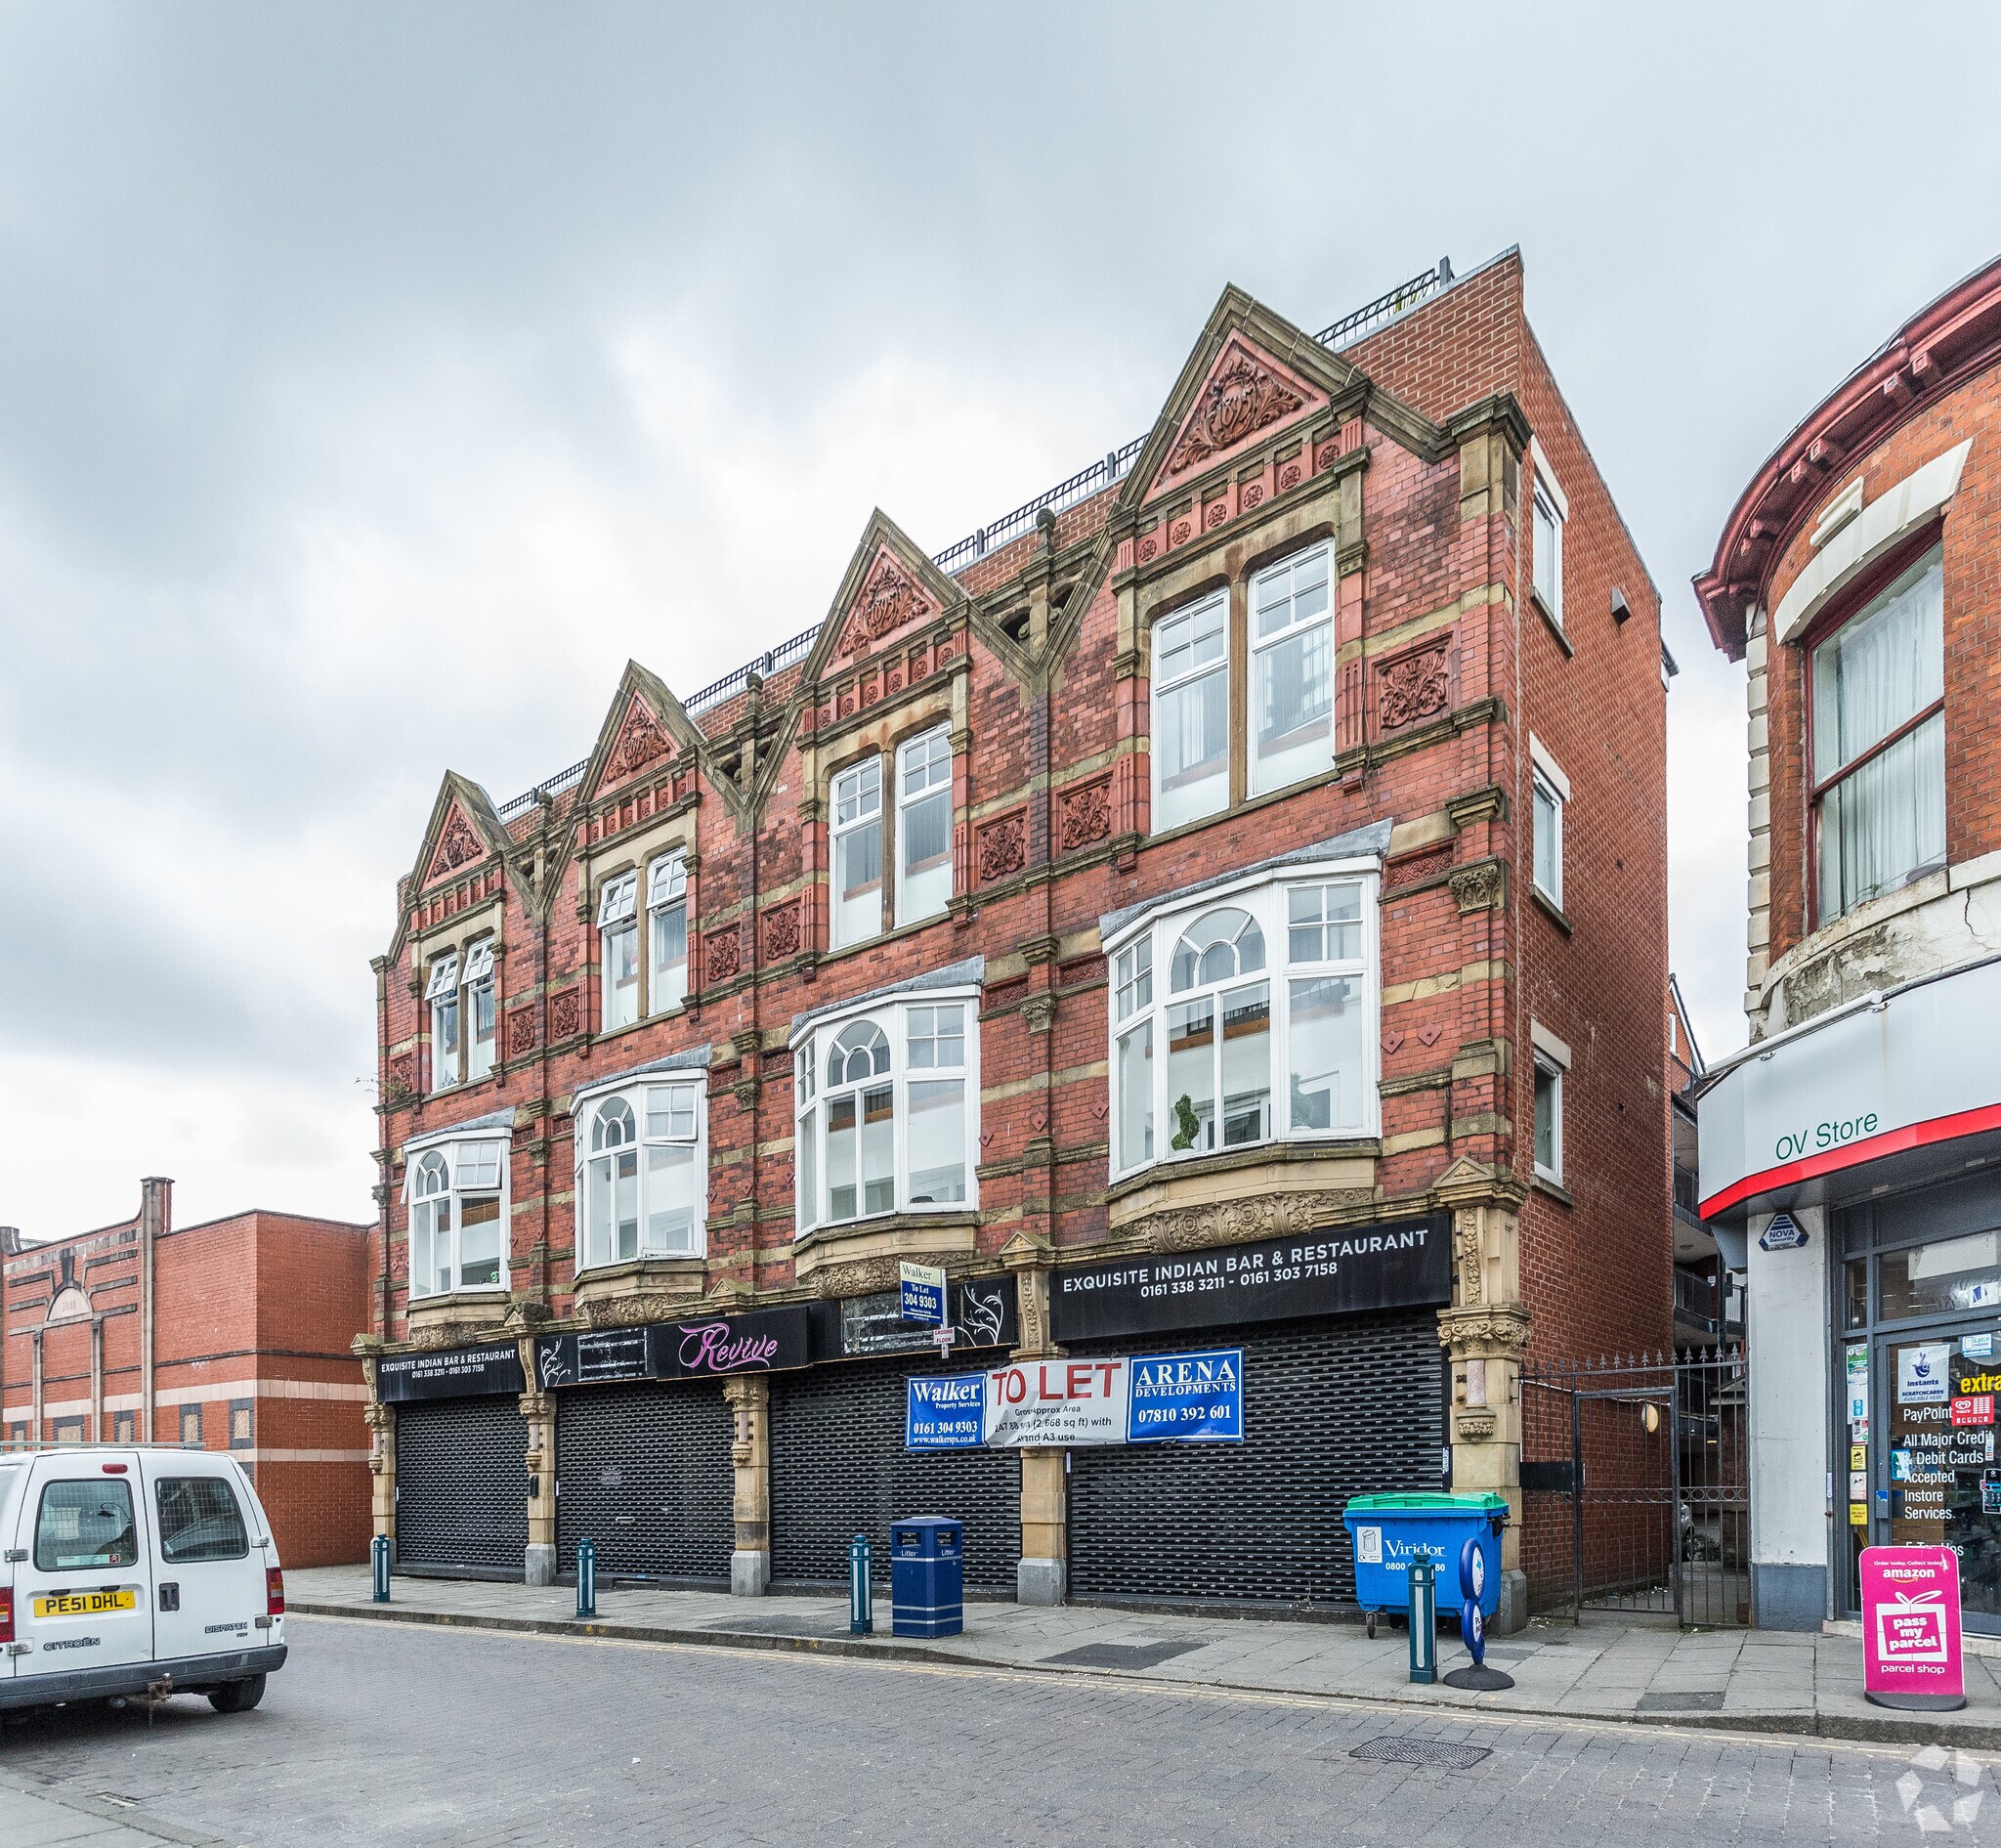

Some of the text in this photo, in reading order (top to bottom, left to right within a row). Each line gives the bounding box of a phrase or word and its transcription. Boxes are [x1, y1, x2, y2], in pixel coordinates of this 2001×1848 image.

[1776, 1113, 1878, 1160] OV Store
[1769, 1228, 1795, 1238] NOVA
[1063, 1229, 1428, 1293] EXQUISITE INDIAN BAR & RESTAURANT
[902, 1264, 932, 1280] Walker
[1140, 1283, 1168, 1298] 0161
[1171, 1280, 1194, 1294] 338
[1198, 1276, 1224, 1291] 3211
[1240, 1271, 1269, 1286] 0161
[1273, 1267, 1300, 1282] 303
[1305, 1262, 1338, 1278] 7158
[911, 1283, 929, 1294] To Let
[904, 1292, 937, 1310] 304 9303
[678, 1322, 779, 1371] Revive
[381, 1350, 515, 1373] EXQUISITE INDIAN BAR & RESTAURANT
[411, 1370, 423, 1379] 0161
[423, 1368, 433, 1377] 338
[434, 1367, 446, 1377] 3211
[448, 1365, 460, 1375] 0161
[461, 1365, 472, 1374] 303
[472, 1363, 485, 1372] 7158
[1136, 1359, 1236, 1386] ARENA
[992, 1362, 1122, 1405] TO LET
[1135, 1382, 1236, 1397] DEVELOPMENTS
[1960, 1372, 2001, 1394] extra
[913, 1383, 980, 1403] Walker
[1901, 1389, 1944, 1397] SCRATCHCARDS
[935, 1401, 958, 1410] Property
[1138, 1404, 1231, 1423] 07810 392 601
[1063, 1419, 1076, 1428] sq
[1078, 1417, 1088, 1427] ft)
[1091, 1417, 1112, 1426] with
[1903, 1406, 1953, 1423] PayPoint
[914, 1420, 978, 1435] 0161 304 9303
[914, 1435, 977, 1444] www.walkersps.co.uk
[1043, 1433, 1055, 1441] A3
[1903, 1431, 1994, 1448] All Major Credit
[1916, 1451, 1946, 1465] Debit
[1949, 1449, 1983, 1464] Cards
[1903, 1470, 1955, 1485] Accepted
[1904, 1489, 1943, 1502] Instore
[1905, 1506, 1955, 1520] Services.
[1384, 1539, 1445, 1557] Viridor
[1883, 1569, 1936, 1578] amazon
[46, 1594, 124, 1613] PE51 DHL
[1893, 1617, 1927, 1630] pass
[1899, 1628, 1923, 1638] my
[43, 1637, 101, 1652] CITROËN
[1889, 1636, 1937, 1652] parcel
[1881, 1664, 1945, 1675] parcel shop
